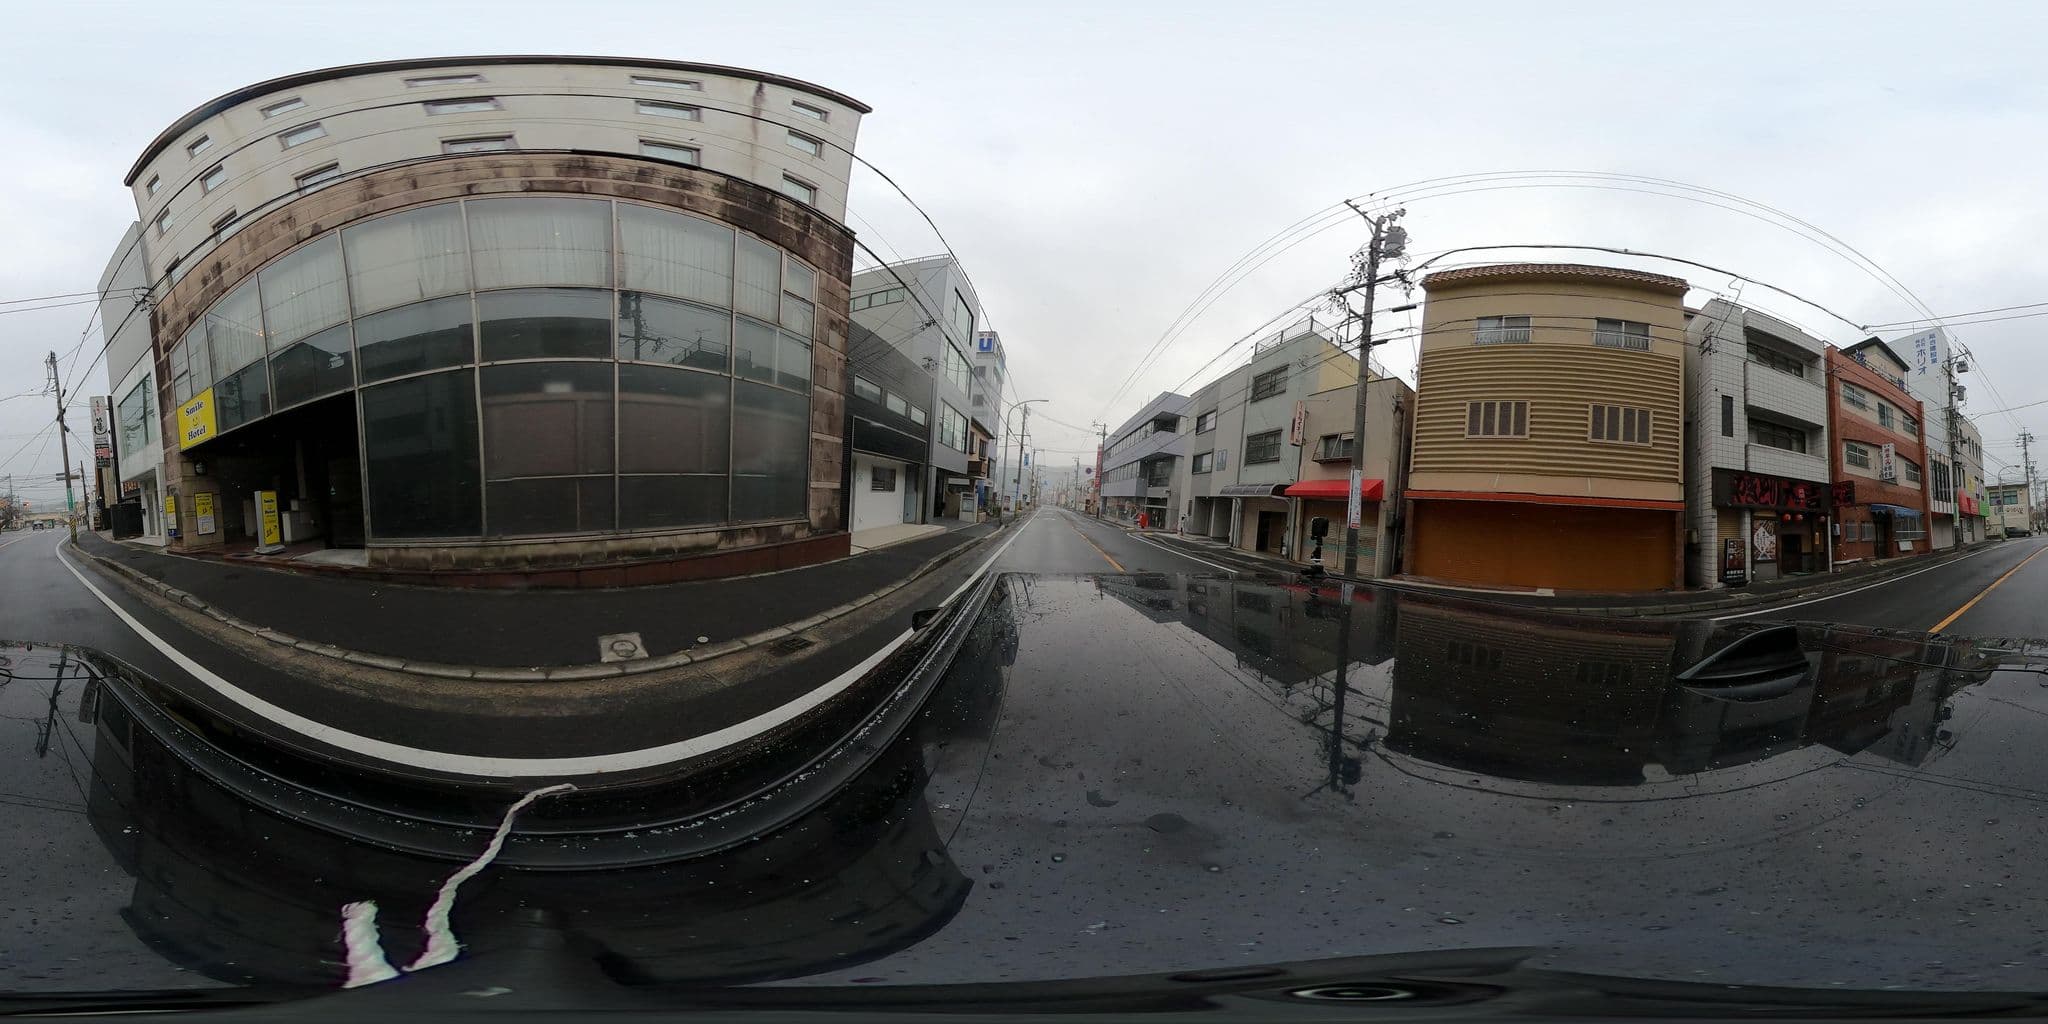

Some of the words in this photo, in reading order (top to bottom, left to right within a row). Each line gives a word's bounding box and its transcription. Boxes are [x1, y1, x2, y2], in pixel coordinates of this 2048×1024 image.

[979, 338, 992, 351] U
[1916, 349, 1927, 375] ホリオ
[185, 401, 203, 416] Smile
[187, 425, 206, 440] Hotel
